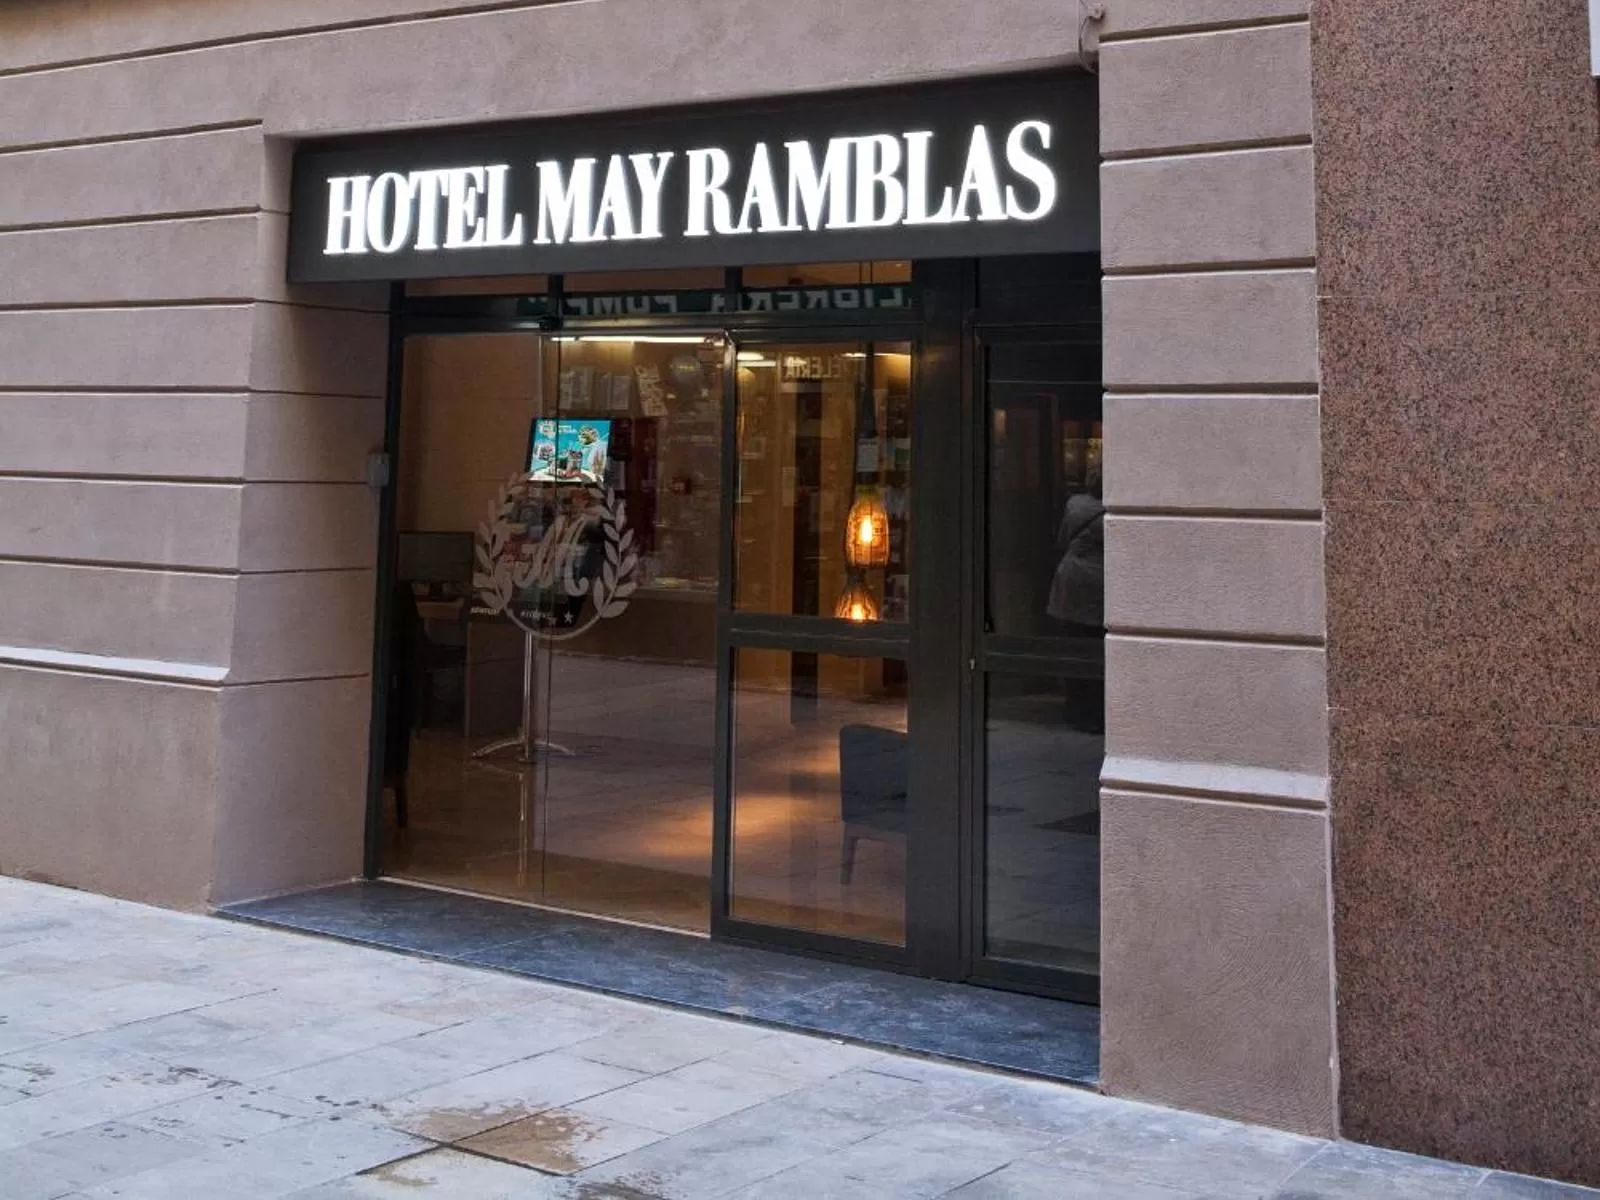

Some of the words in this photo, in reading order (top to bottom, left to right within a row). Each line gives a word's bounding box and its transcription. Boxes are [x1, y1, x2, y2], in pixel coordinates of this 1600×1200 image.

[322, 164, 524, 257] HOTEL
[532, 150, 676, 245] MAY
[684, 120, 1058, 237] RAMBLAS
